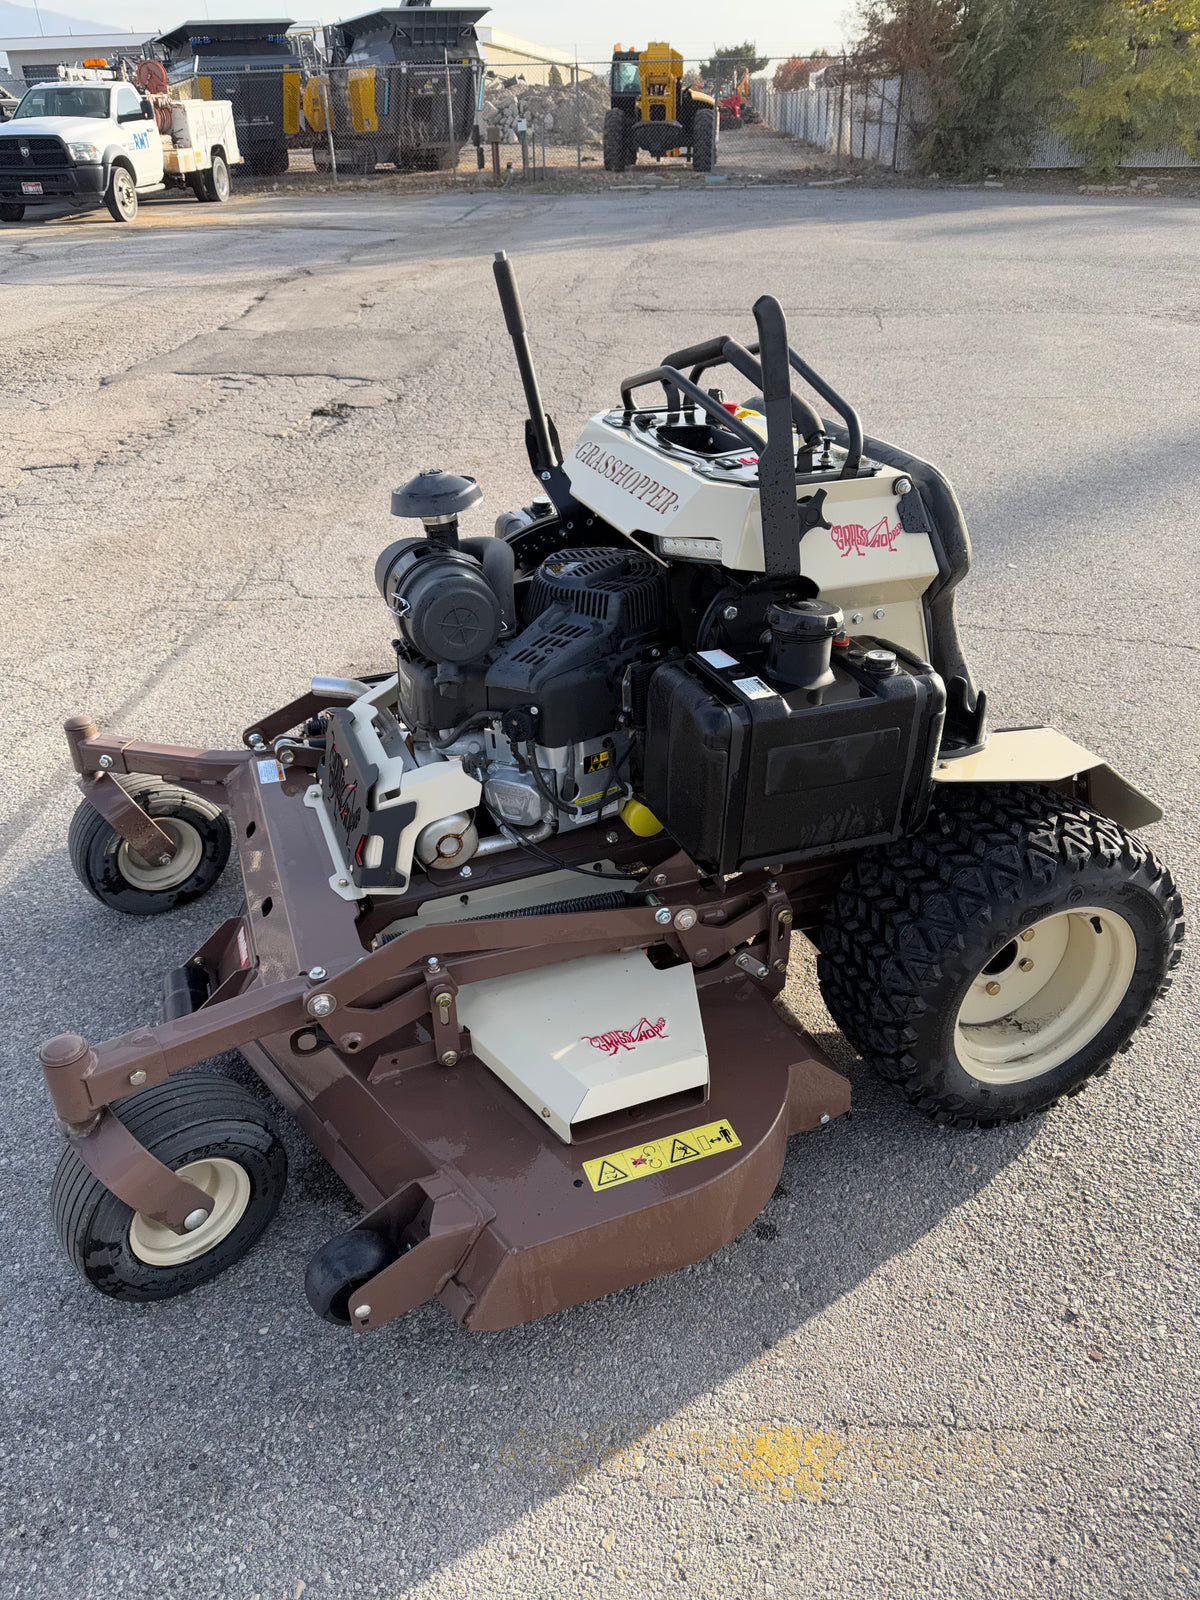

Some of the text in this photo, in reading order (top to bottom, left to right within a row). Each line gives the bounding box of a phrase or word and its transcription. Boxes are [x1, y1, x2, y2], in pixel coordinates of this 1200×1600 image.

[133, 132, 150, 150] RMT
[575, 441, 679, 515] GRASSHOPPER
[831, 517, 903, 552] GRASSHOPPER
